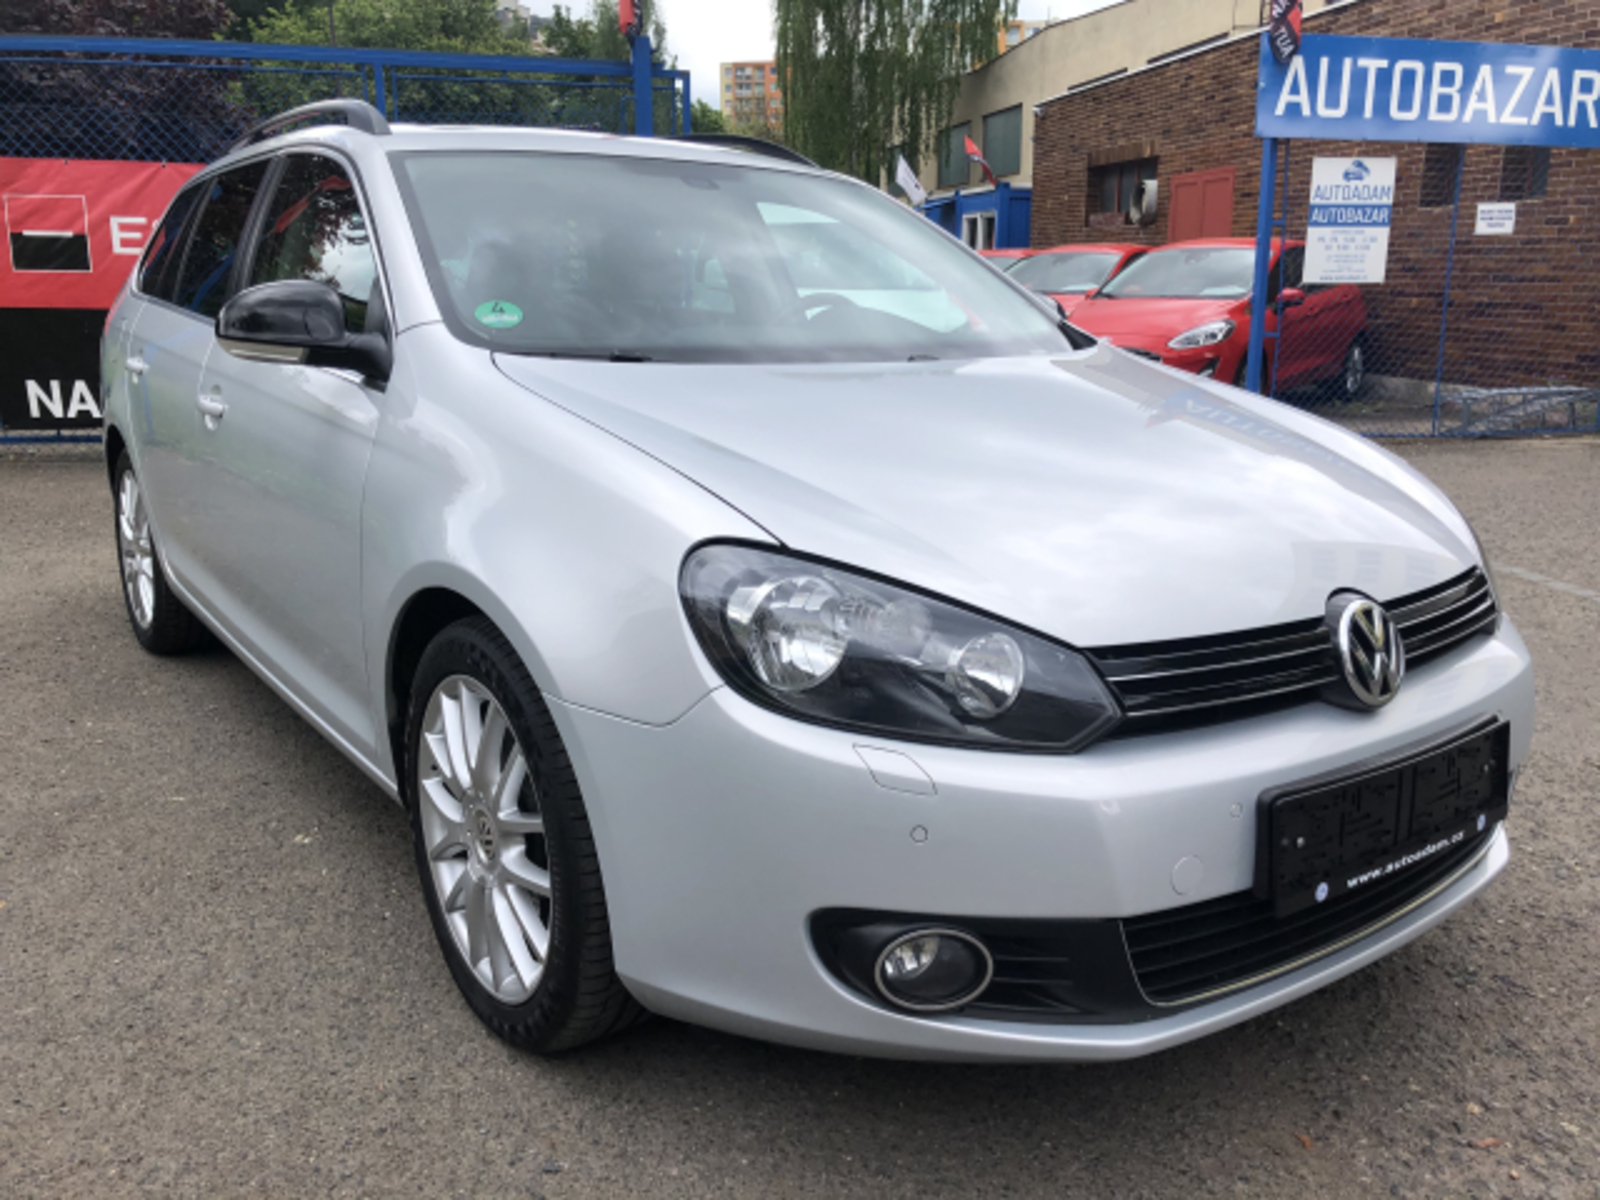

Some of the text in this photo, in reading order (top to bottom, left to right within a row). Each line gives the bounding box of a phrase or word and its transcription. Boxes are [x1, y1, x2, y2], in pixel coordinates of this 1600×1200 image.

[1274, 54, 1600, 129] AUTOBAZAR
[1312, 184, 1392, 201] AUTOADAM
[1310, 206, 1390, 224] AUTOBAZAR
[109, 215, 162, 255] E
